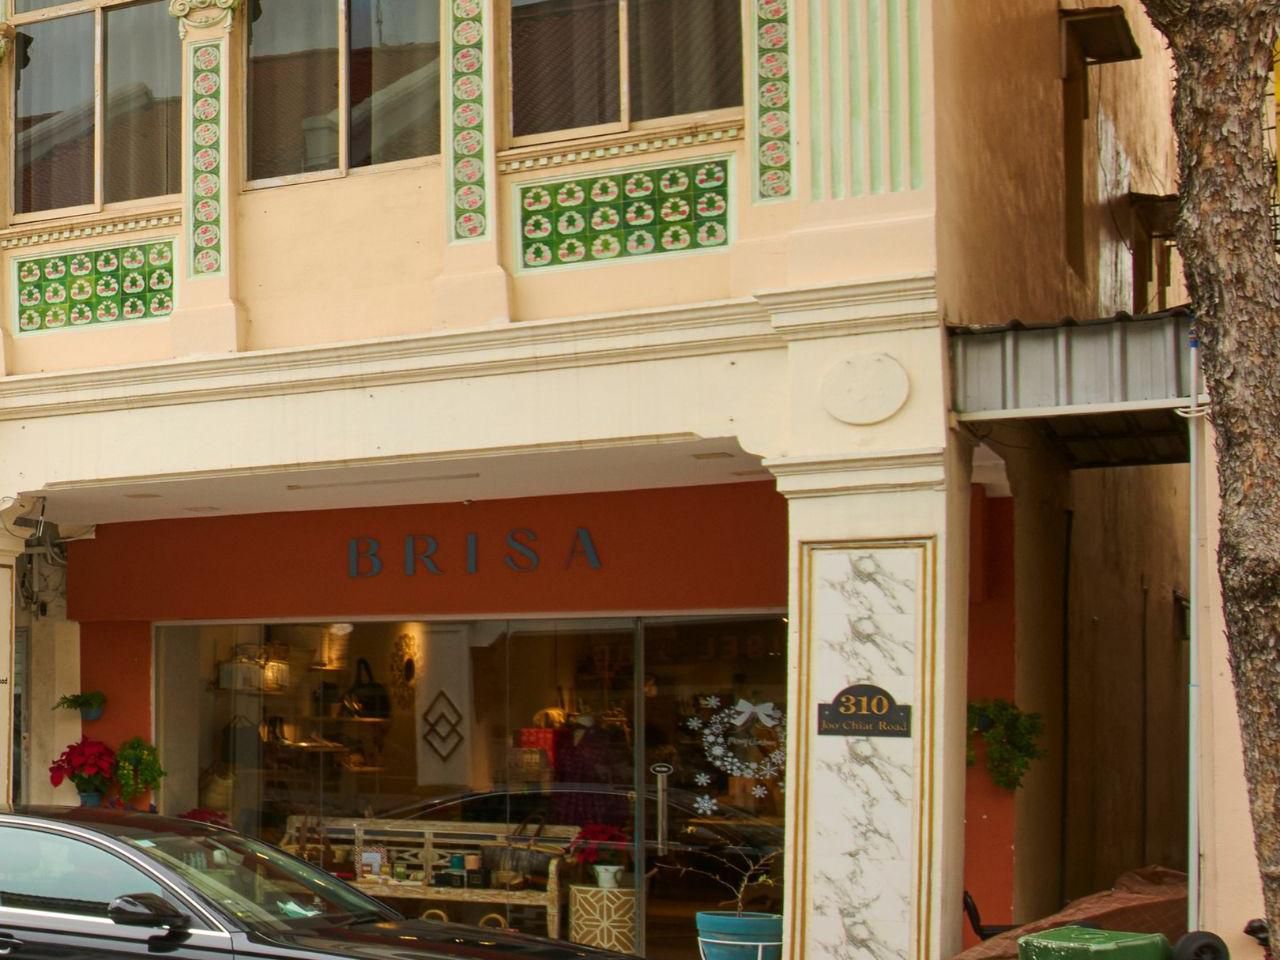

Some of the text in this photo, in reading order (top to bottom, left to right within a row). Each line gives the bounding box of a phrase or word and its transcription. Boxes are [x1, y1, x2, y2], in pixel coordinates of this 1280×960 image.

[348, 527, 603, 579] BRISA
[838, 695, 890, 715] 310
[821, 720, 908, 731] Joo Chiat Road
